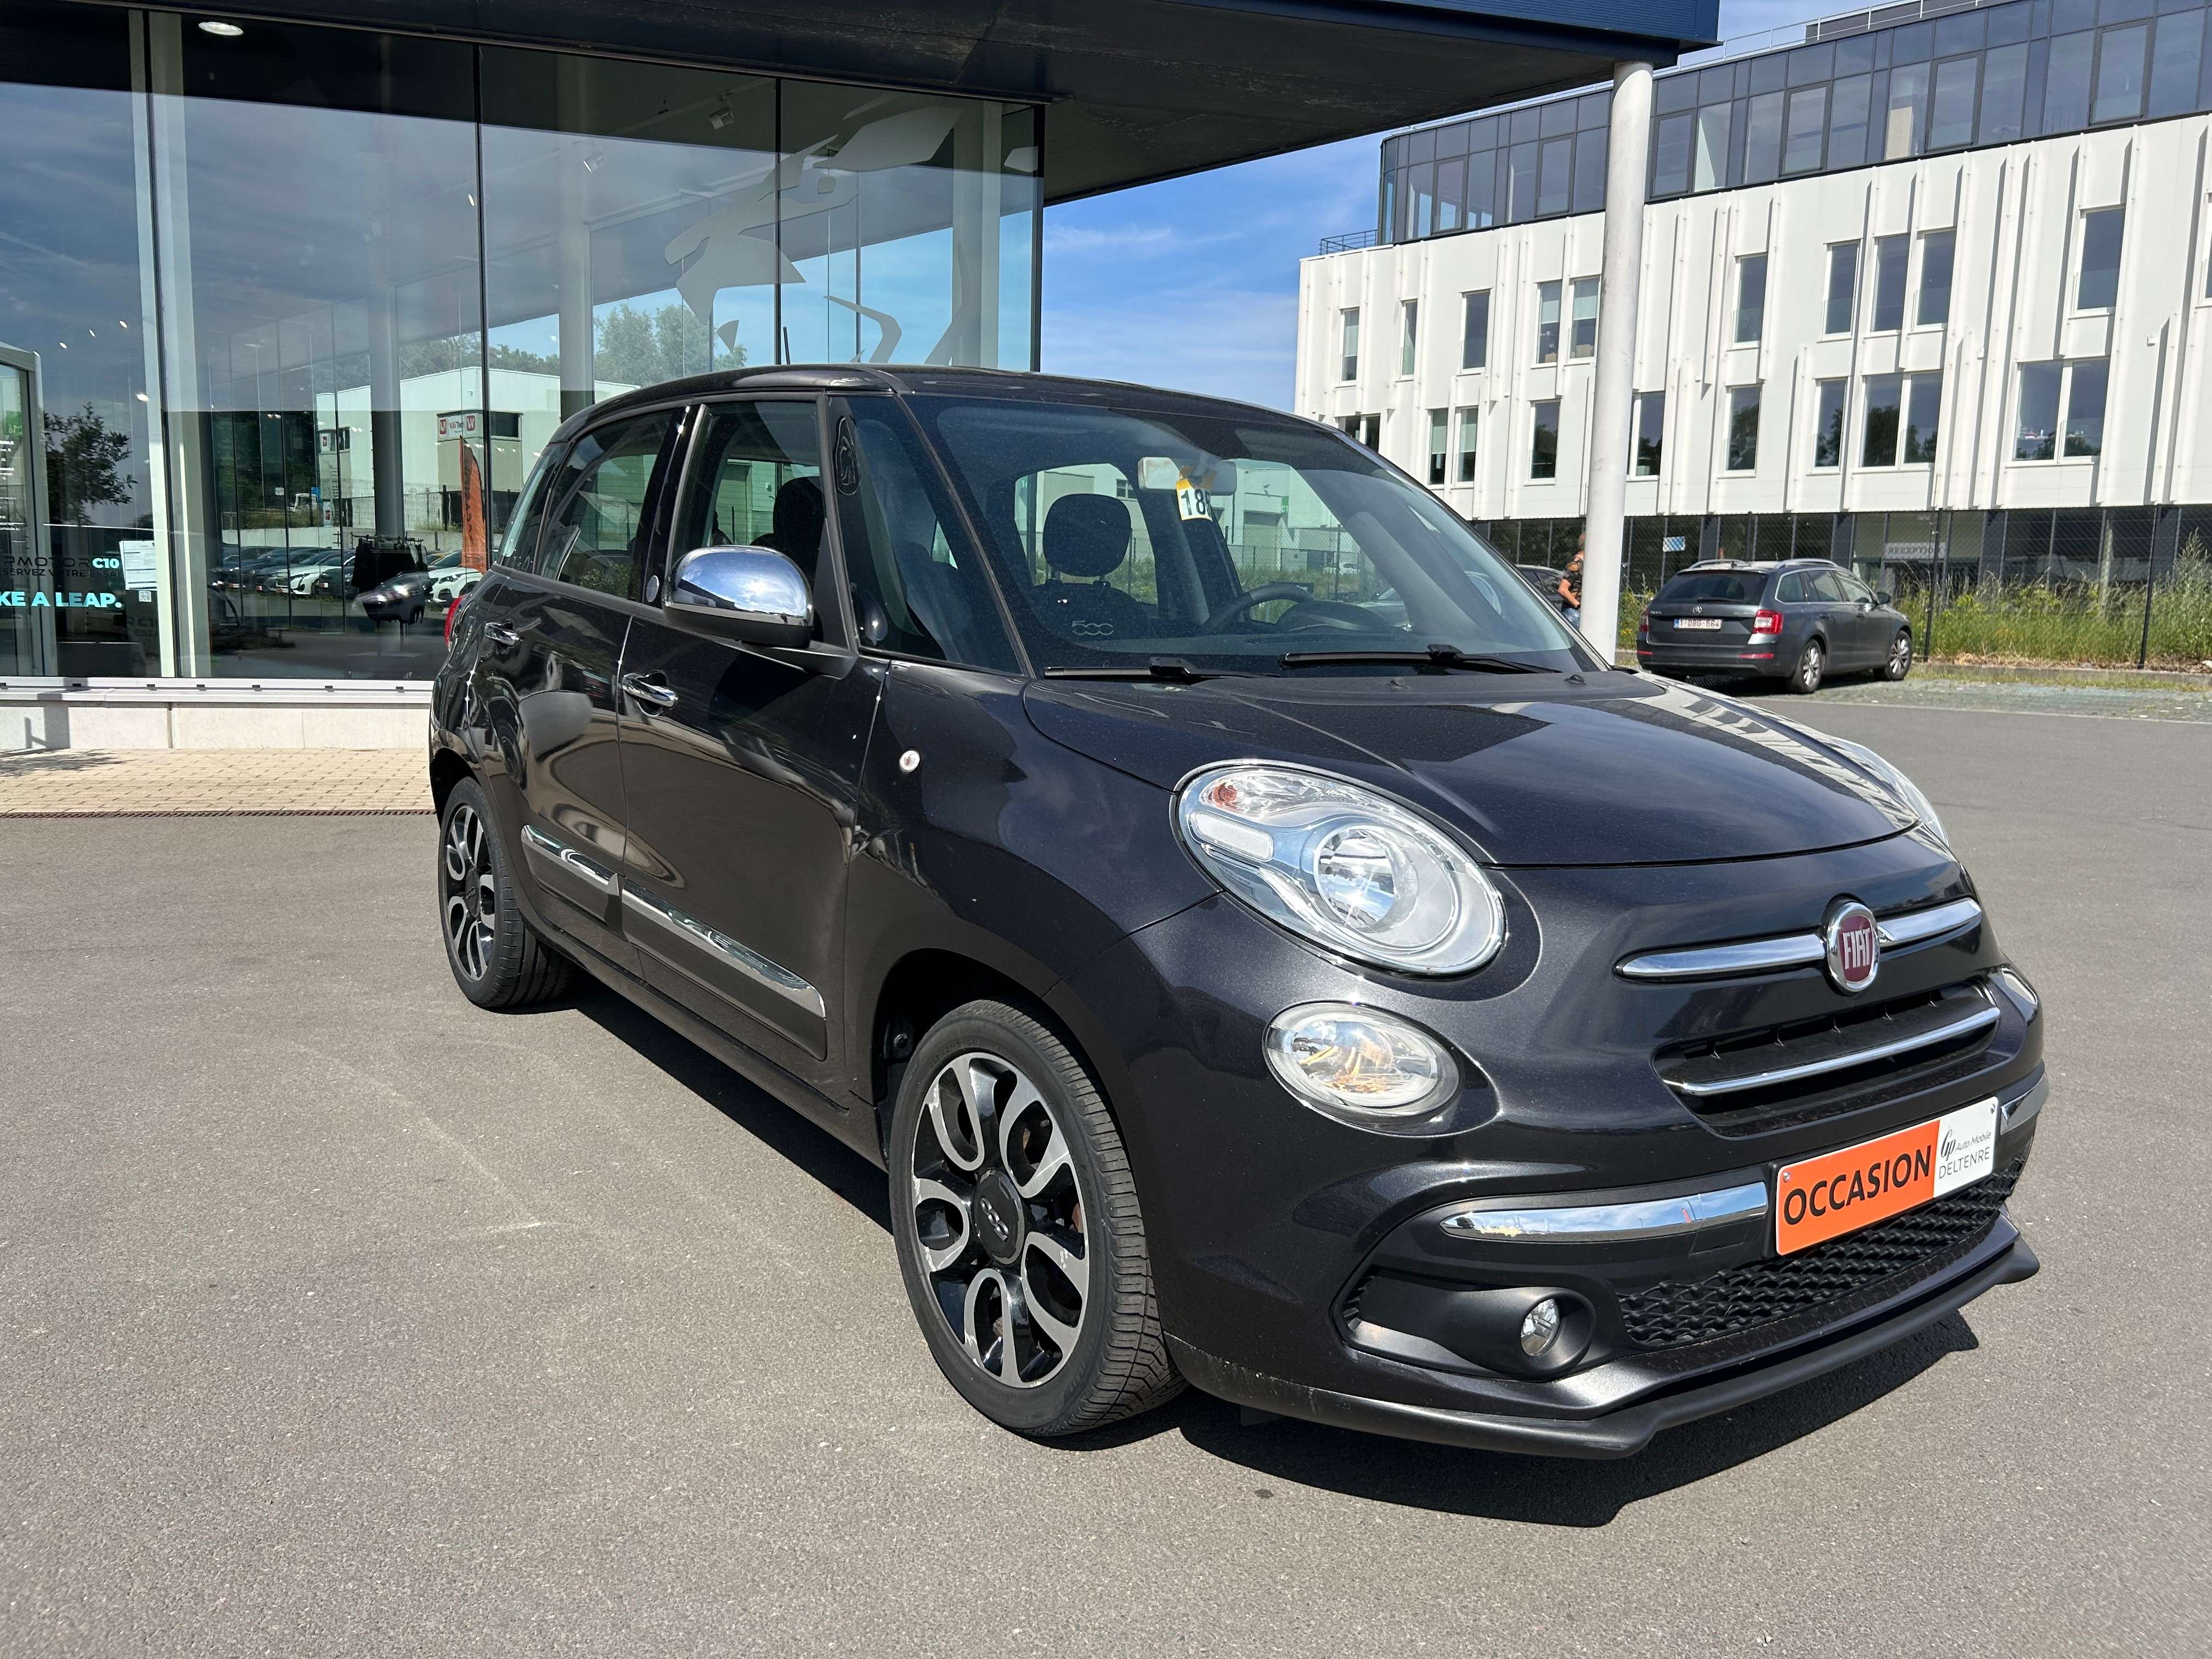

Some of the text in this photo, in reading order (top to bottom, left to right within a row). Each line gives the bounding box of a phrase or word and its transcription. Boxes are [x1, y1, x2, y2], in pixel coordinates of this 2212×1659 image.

[1888, 546, 1941, 554] RECEPTIO
[92, 557, 120, 569] C10
[0, 568, 46, 577] SERVEZ
[31, 591, 50, 607] A
[55, 592, 122, 608] LEAP.
[1842, 927, 1871, 970] FIAT
[1939, 1146, 1990, 1180] DELTENRE
[1784, 1144, 1932, 1225] OCCASION
